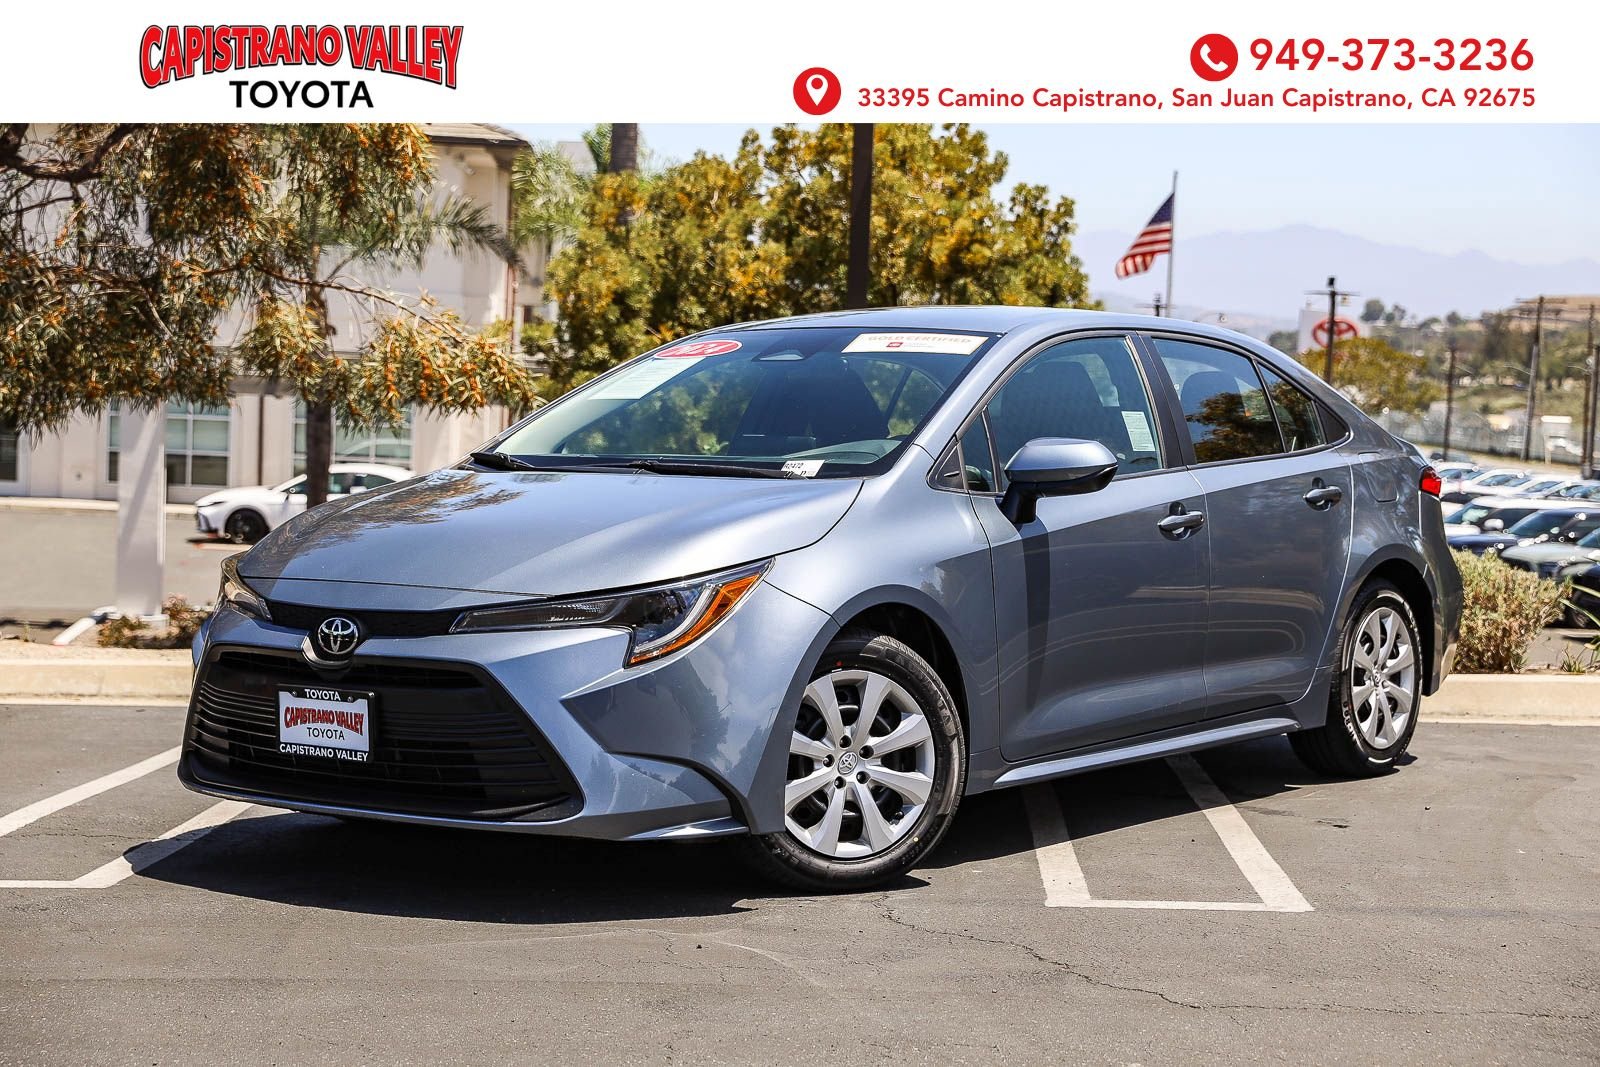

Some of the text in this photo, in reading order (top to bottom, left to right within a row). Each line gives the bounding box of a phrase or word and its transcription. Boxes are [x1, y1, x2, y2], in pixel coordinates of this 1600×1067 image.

[304, 689, 341, 701] TOYOTA
[284, 706, 364, 736] CAPISTRANO VALLEY
[306, 727, 345, 740] TOYOTA
[280, 743, 368, 761] CAPISTRANO VALLEY
